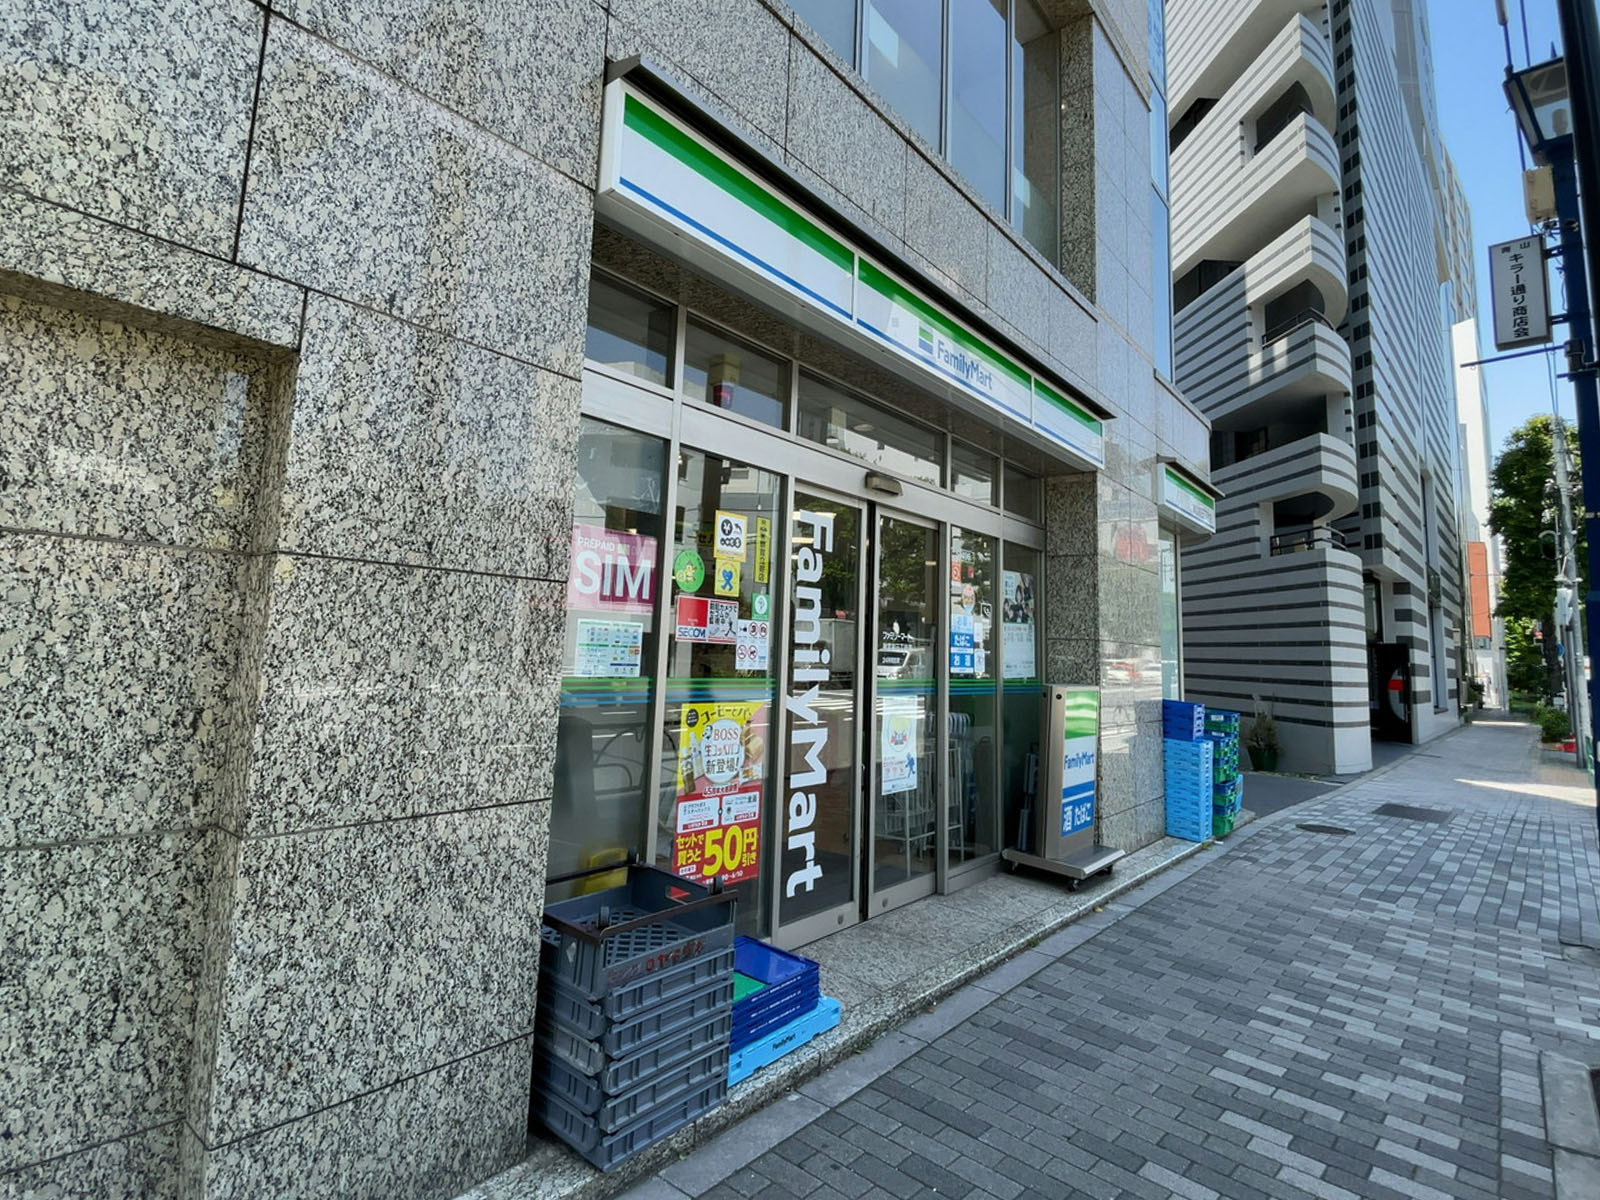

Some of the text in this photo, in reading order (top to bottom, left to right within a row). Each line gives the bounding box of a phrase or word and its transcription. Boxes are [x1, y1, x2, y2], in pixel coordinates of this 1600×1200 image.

[1508, 252, 1530, 338] キラー通り商店会
[937, 339, 993, 390] FamilyMart
[577, 535, 616, 552] PREPAID
[573, 549, 652, 600] SIM
[677, 626, 706, 638] SECOM
[785, 509, 835, 898] FamilyMart
[714, 727, 739, 741] BOSS
[1064, 751, 1094, 770] FamilyMart
[1073, 802, 1092, 827] たばこ
[676, 832, 705, 850] セットで
[702, 825, 743, 876] 50
[743, 827, 758, 853] 円
